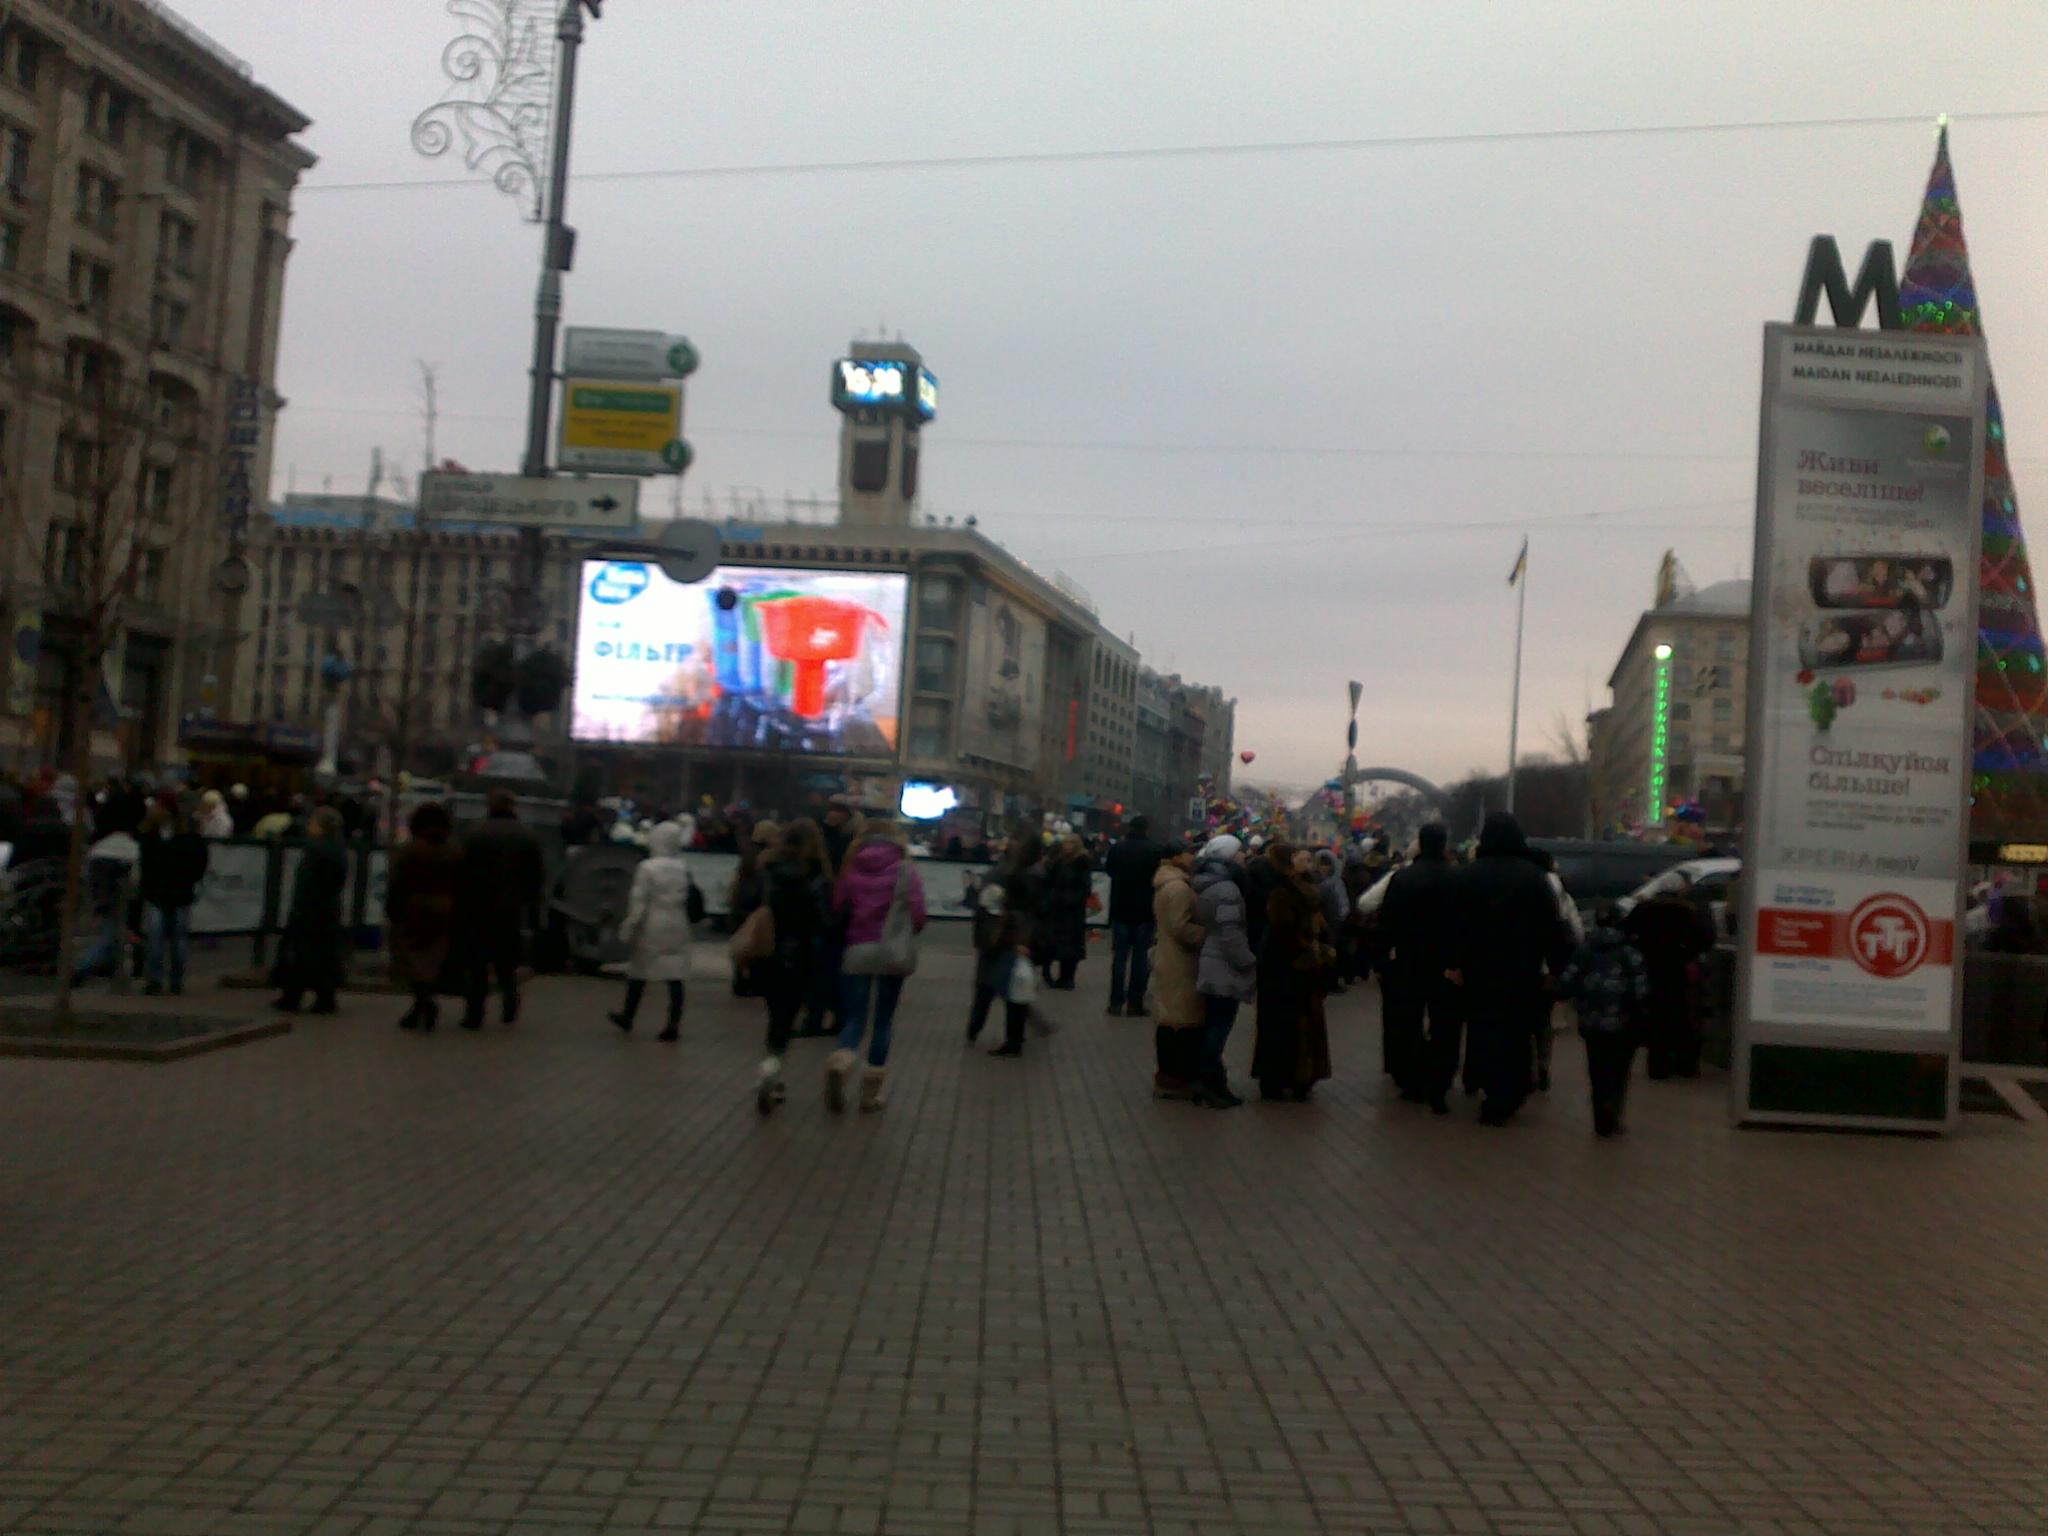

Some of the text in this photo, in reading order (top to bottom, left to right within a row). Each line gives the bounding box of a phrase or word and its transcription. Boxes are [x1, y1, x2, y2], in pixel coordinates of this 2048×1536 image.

[1793, 234, 1901, 329] М
[1793, 340, 1855, 358] МАЙДАН
[1793, 366, 1850, 381] MAIDAN
[1798, 450, 1880, 475] Живи
[1809, 745, 1951, 775] Спілкуйся
[1809, 771, 1911, 796] більше!
